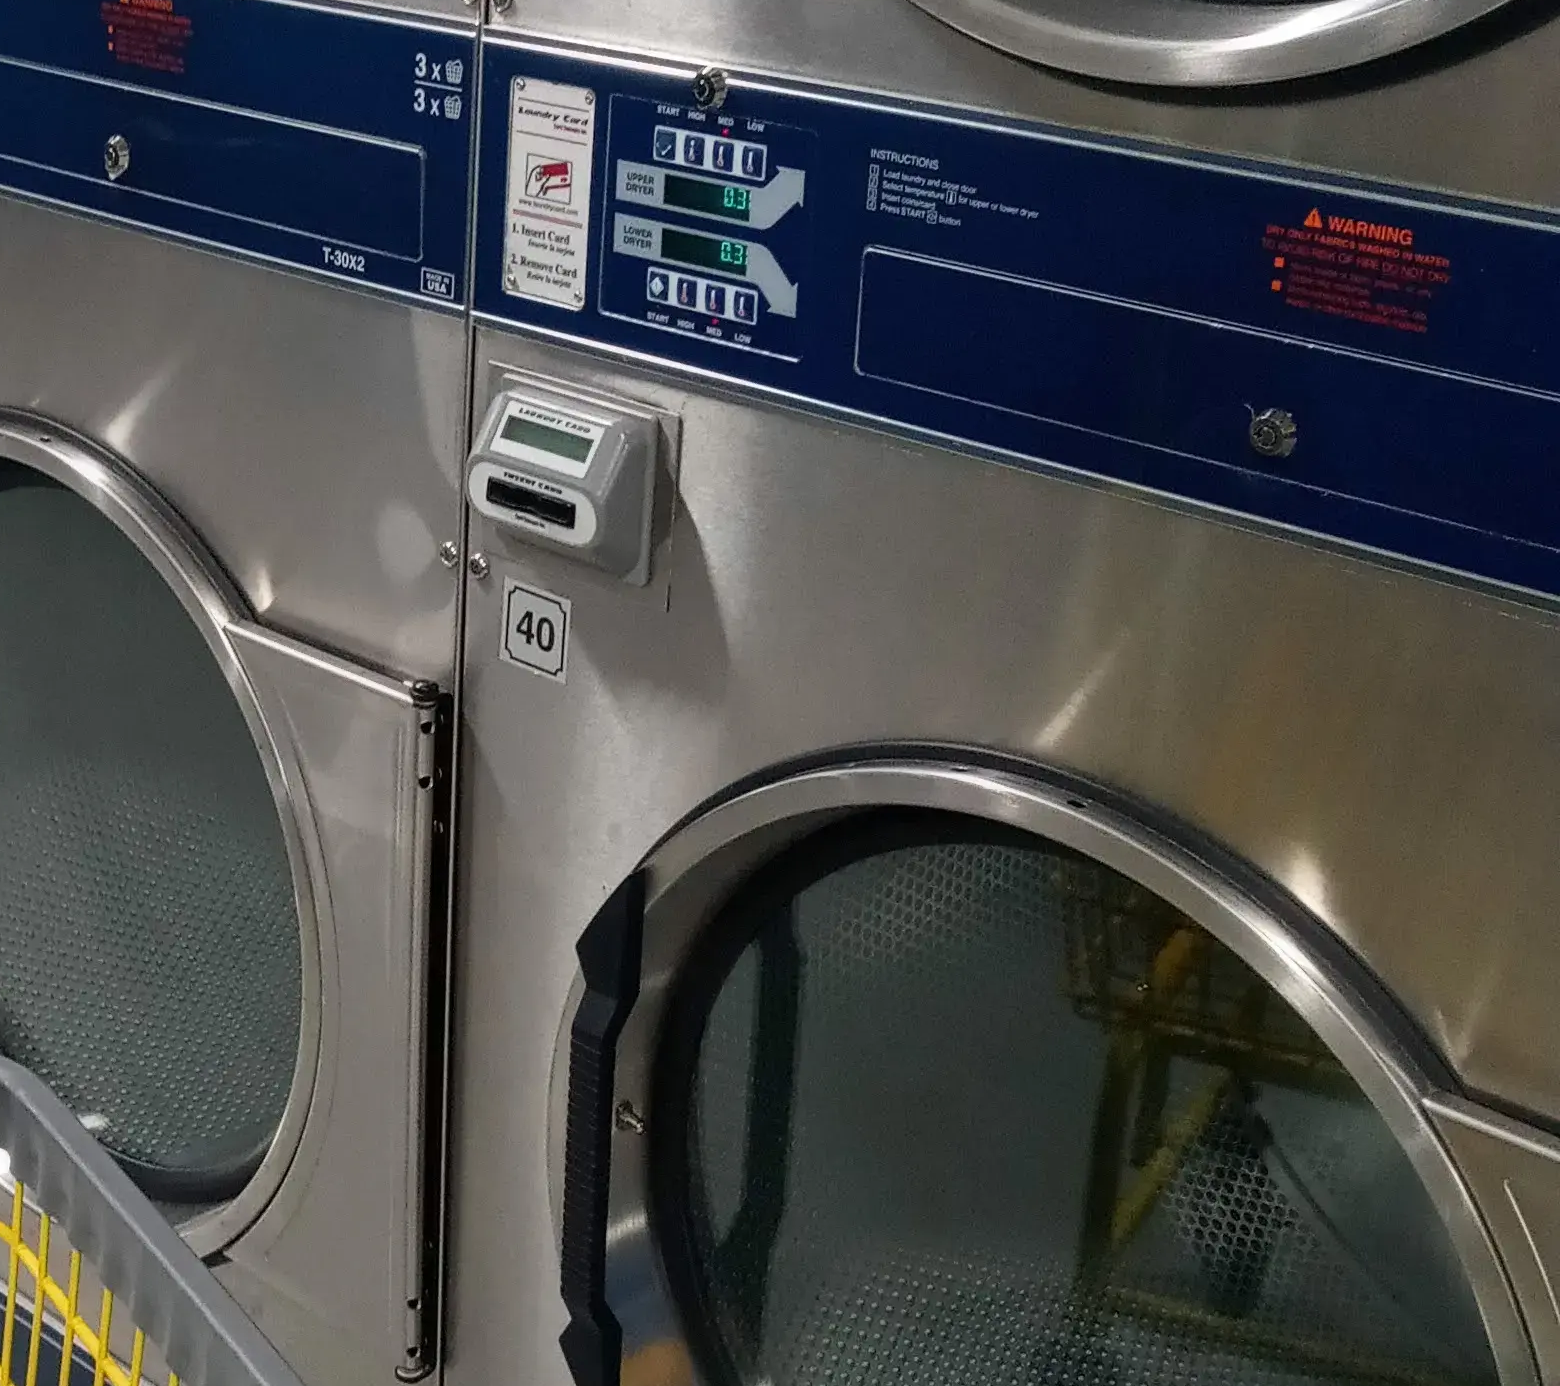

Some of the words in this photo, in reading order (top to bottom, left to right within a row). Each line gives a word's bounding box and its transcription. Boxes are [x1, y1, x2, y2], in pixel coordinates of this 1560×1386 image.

[414, 52, 427, 78] 3
[431, 63, 441, 81] x
[413, 88, 425, 113] 3
[430, 98, 440, 117] x
[518, 106, 560, 123] Laundry
[563, 114, 589, 127] Card
[657, 104, 680, 117] START
[718, 116, 734, 127] MED
[747, 120, 765, 133] LOW
[870, 148, 940, 170] INSTRUCTIONS
[626, 182, 654, 196] DRYER
[627, 171, 654, 185] UPPER
[883, 169, 900, 180] Load
[901, 173, 926, 187] laundry
[926, 178, 940, 187] and
[941, 180, 960, 191] close
[961, 184, 977, 195] door
[881, 192, 900, 203] Insert
[882, 180, 903, 192] Select
[904, 185, 945, 201] temperature
[958, 195, 968, 204] for
[968, 199, 990, 210] upper
[990, 203, 998, 211] or
[999, 204, 1019, 215] lower
[1020, 208, 1039, 219] dryer
[880, 203, 900, 215] Press
[901, 207, 925, 219] START
[938, 215, 962, 227] button
[512, 223, 519, 234] 1.
[521, 224, 547, 240] Insert
[548, 231, 571, 245] Card
[623, 225, 653, 239] LOWER
[623, 235, 652, 250] DRYER
[1327, 215, 1414, 246] WARNING
[322, 246, 365, 272] T-30X2
[1287, 228, 1312, 241] ONLY
[1314, 234, 1356, 250] FABRICS
[1358, 243, 1400, 258] WASHED
[1414, 253, 1451, 268] WATER
[520, 255, 555, 274] Remove
[556, 262, 578, 279] Card
[1338, 252, 1354, 264] OF
[1382, 262, 1399, 275] DO
[1401, 265, 1426, 279] NOT
[1428, 270, 1451, 284] DRY
[426, 280, 446, 294] USA
[647, 311, 670, 325] START
[706, 325, 722, 337] MED
[734, 332, 752, 344] LOW
[519, 406, 562, 426] LAUNDRY
[565, 420, 591, 434] CARD
[538, 481, 562, 495] CARD
[516, 610, 555, 653] 40
